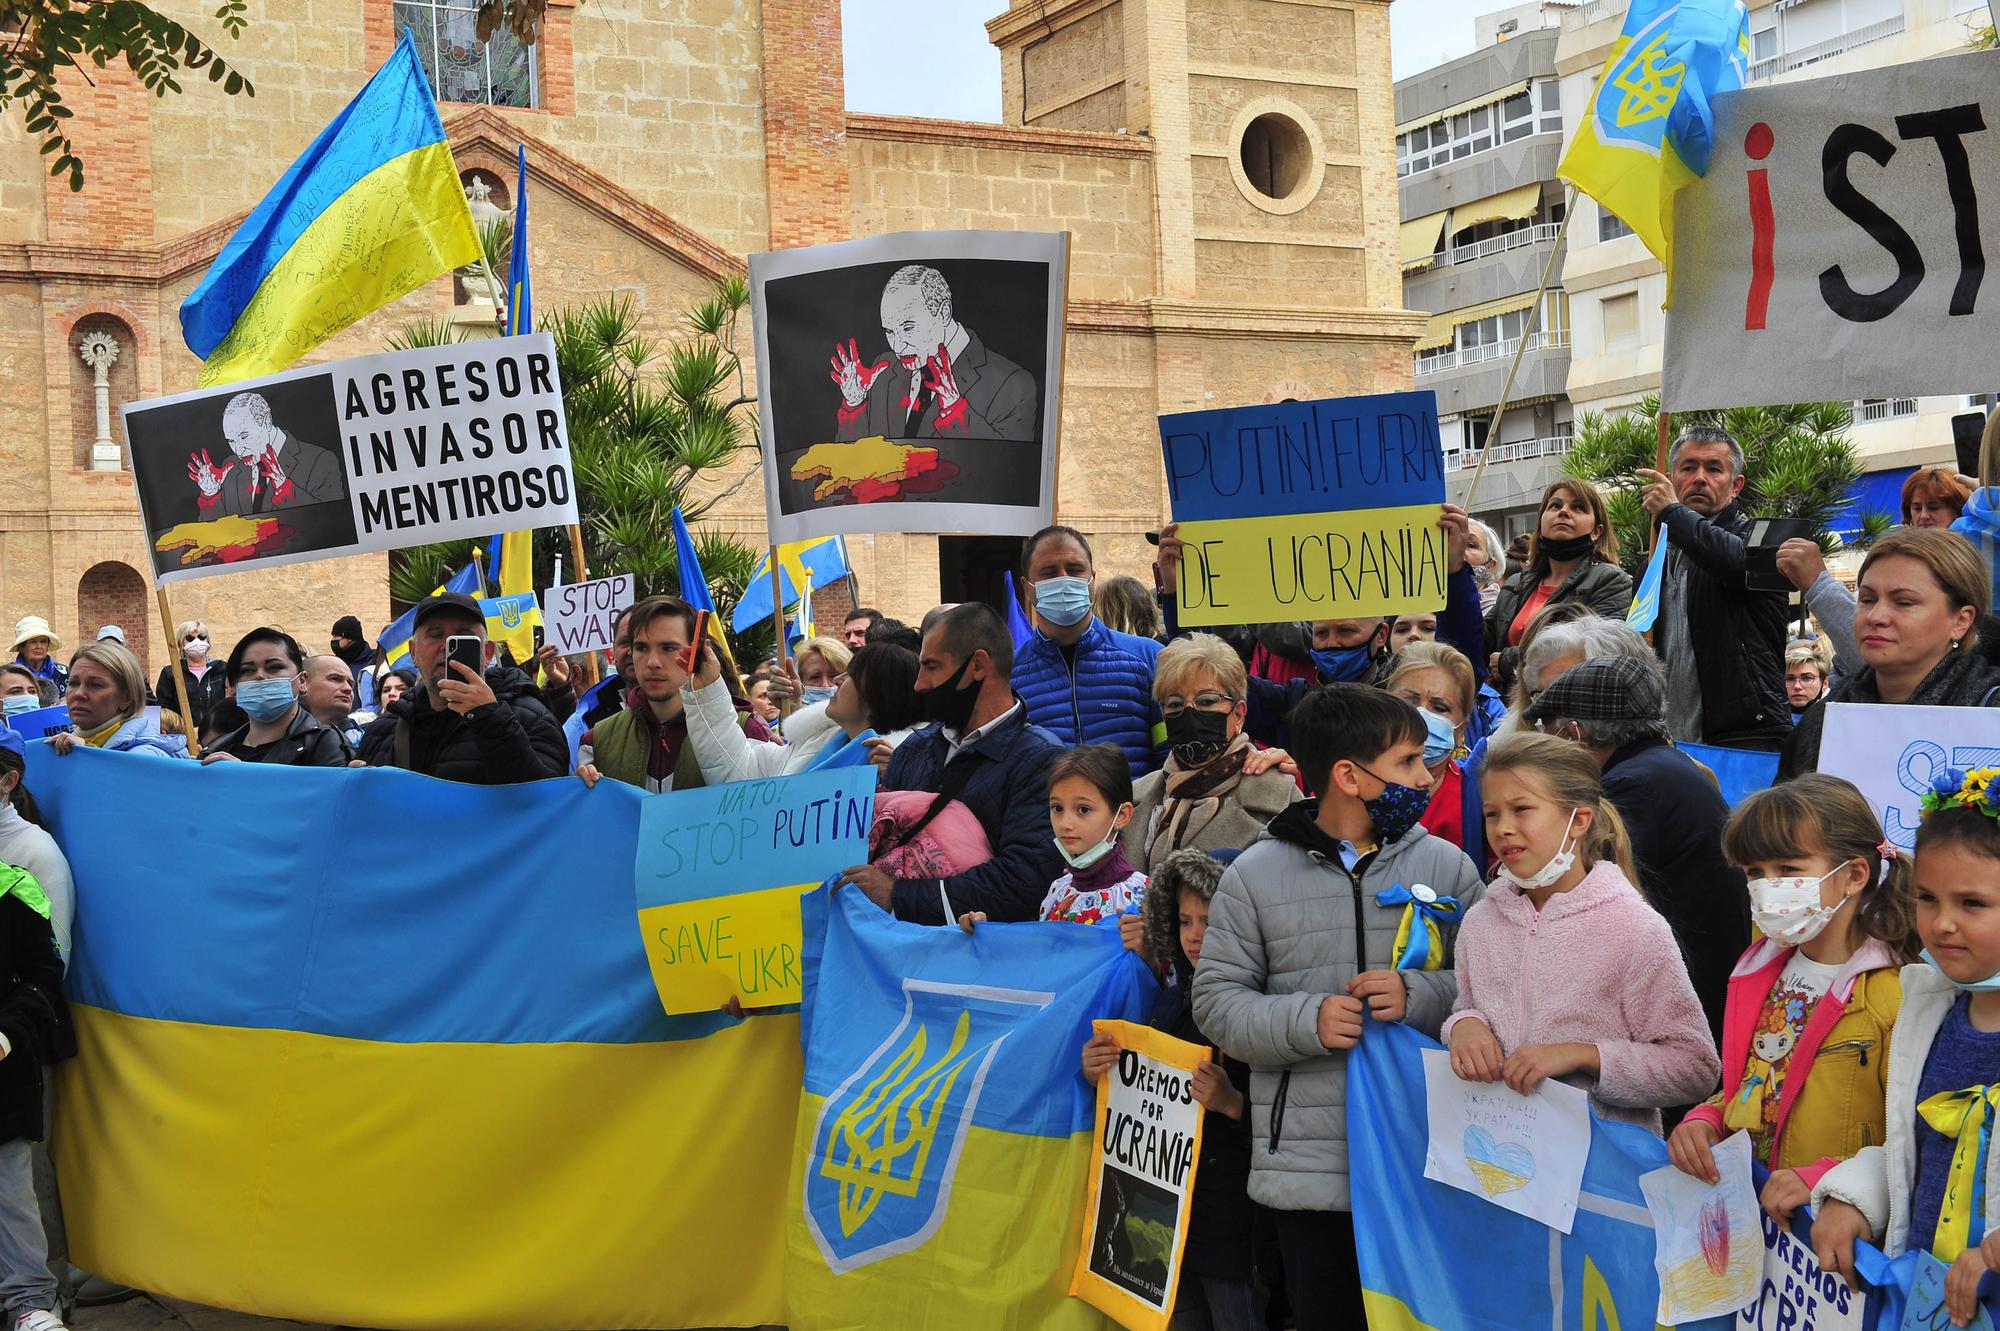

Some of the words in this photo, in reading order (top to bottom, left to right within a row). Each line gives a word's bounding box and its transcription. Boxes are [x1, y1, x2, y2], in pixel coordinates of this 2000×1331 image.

[345, 353, 554, 420] AGRESOR
[349, 409, 563, 477] INVASOR
[359, 464, 570, 534] MENTIROSO
[559, 576, 627, 617] STOP
[1180, 540, 1229, 609] DE
[717, 779, 790, 815] NATO!
[656, 817, 759, 879] STOP
[659, 915, 734, 965] SAVE
[1118, 1049, 1193, 1105] OREMOS
[1140, 1099, 1164, 1121] POR
[1760, 1206, 1852, 1316] OREMOS
[1785, 1273, 1818, 1322] POR
